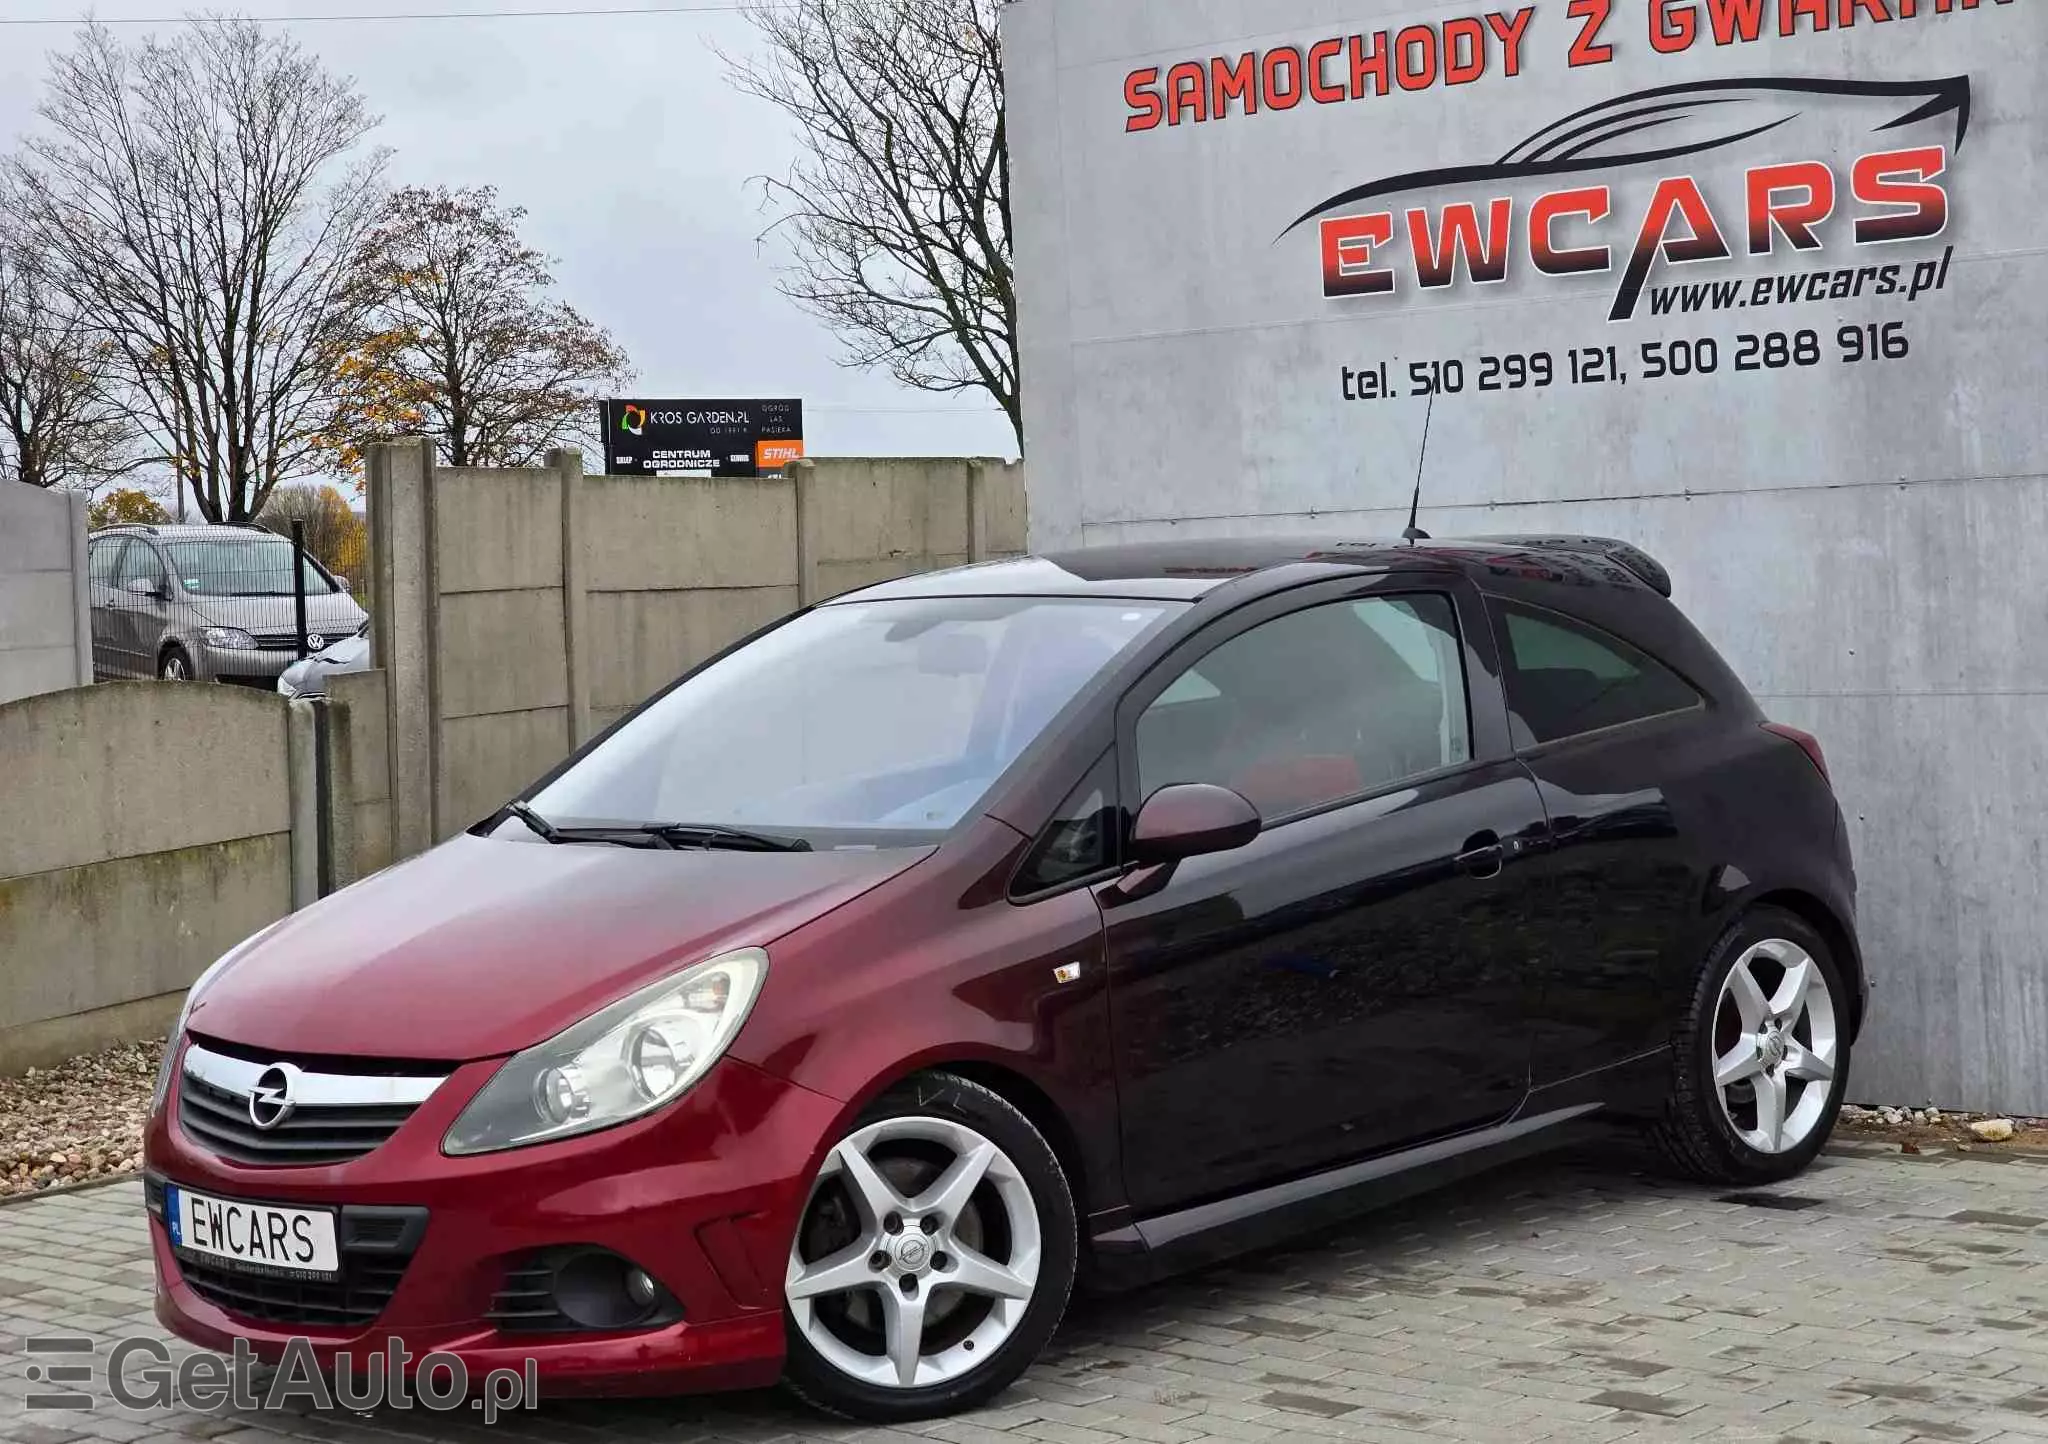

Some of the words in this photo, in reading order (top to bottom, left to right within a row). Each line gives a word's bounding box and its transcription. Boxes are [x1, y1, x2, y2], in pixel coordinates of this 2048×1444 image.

[1124, 6, 1536, 133] SAMOCHODY
[1567, 0, 1613, 68] Z
[1318, 144, 1947, 323] EWCARS
[1649, 246, 1954, 316] www.ewcars.pl
[1341, 362, 1397, 401] tel.
[1408, 359, 1464, 396] 510
[1478, 351, 1553, 391] 299
[1568, 345, 1627, 385] 121,
[1642, 337, 1718, 378] 500
[1734, 329, 1821, 371] 288
[1836, 321, 1910, 363] 916
[650, 411, 682, 424] KROS
[687, 410, 750, 424] GARDEN.PL
[643, 460, 720, 469] OGRODNICZE
[652, 450, 711, 459] CENTRUM
[763, 447, 800, 459] STIHL
[191, 1197, 314, 1263] EWCARS
